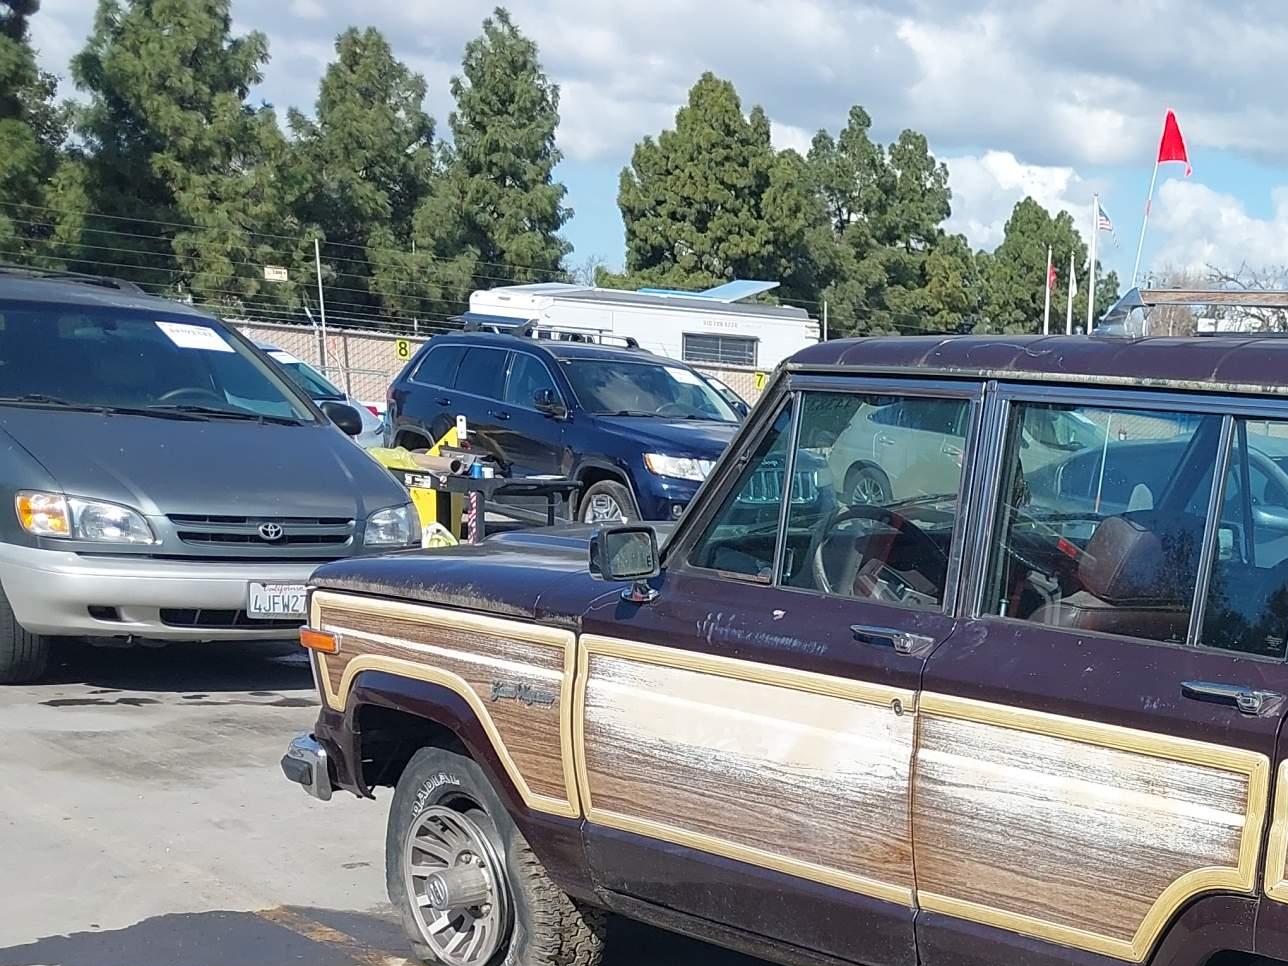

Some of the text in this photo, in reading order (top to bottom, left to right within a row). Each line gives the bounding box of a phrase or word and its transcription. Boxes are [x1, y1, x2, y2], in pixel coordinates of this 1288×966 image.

[399, 341, 408, 357] 8
[756, 373, 764, 387] 7
[412, 772, 461, 818] RADIAL
